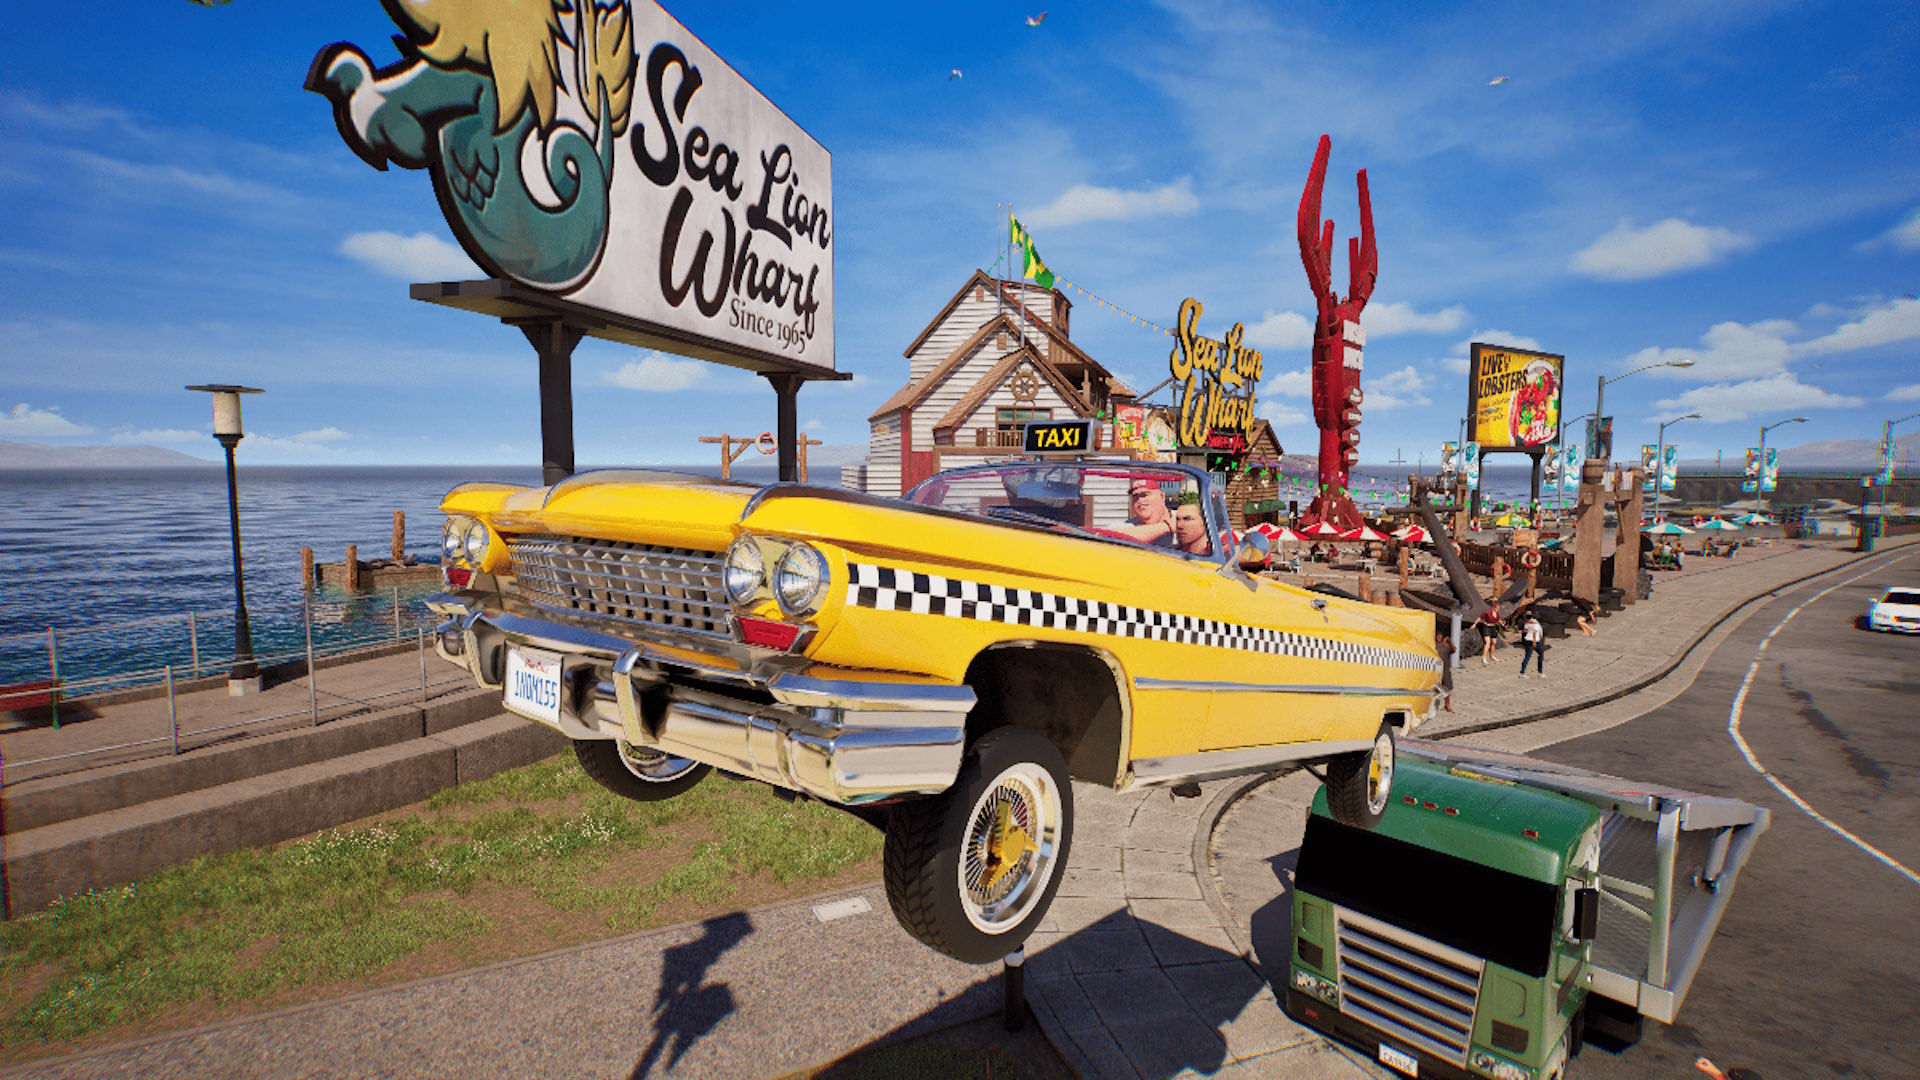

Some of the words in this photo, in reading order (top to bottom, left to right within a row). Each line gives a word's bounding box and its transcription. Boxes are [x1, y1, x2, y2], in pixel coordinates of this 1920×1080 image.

[631, 42, 743, 201] Sea
[746, 145, 831, 250] Lion
[659, 186, 820, 340] Wharf
[729, 297, 774, 334] Since
[776, 319, 806, 354] 1965
[1170, 297, 1220, 380] Sea
[1479, 369, 1529, 399] LOBSTERS
[1481, 353, 1505, 377] LIVE
[1034, 427, 1081, 448] TAXI
[1179, 374, 1257, 447] Wharf
